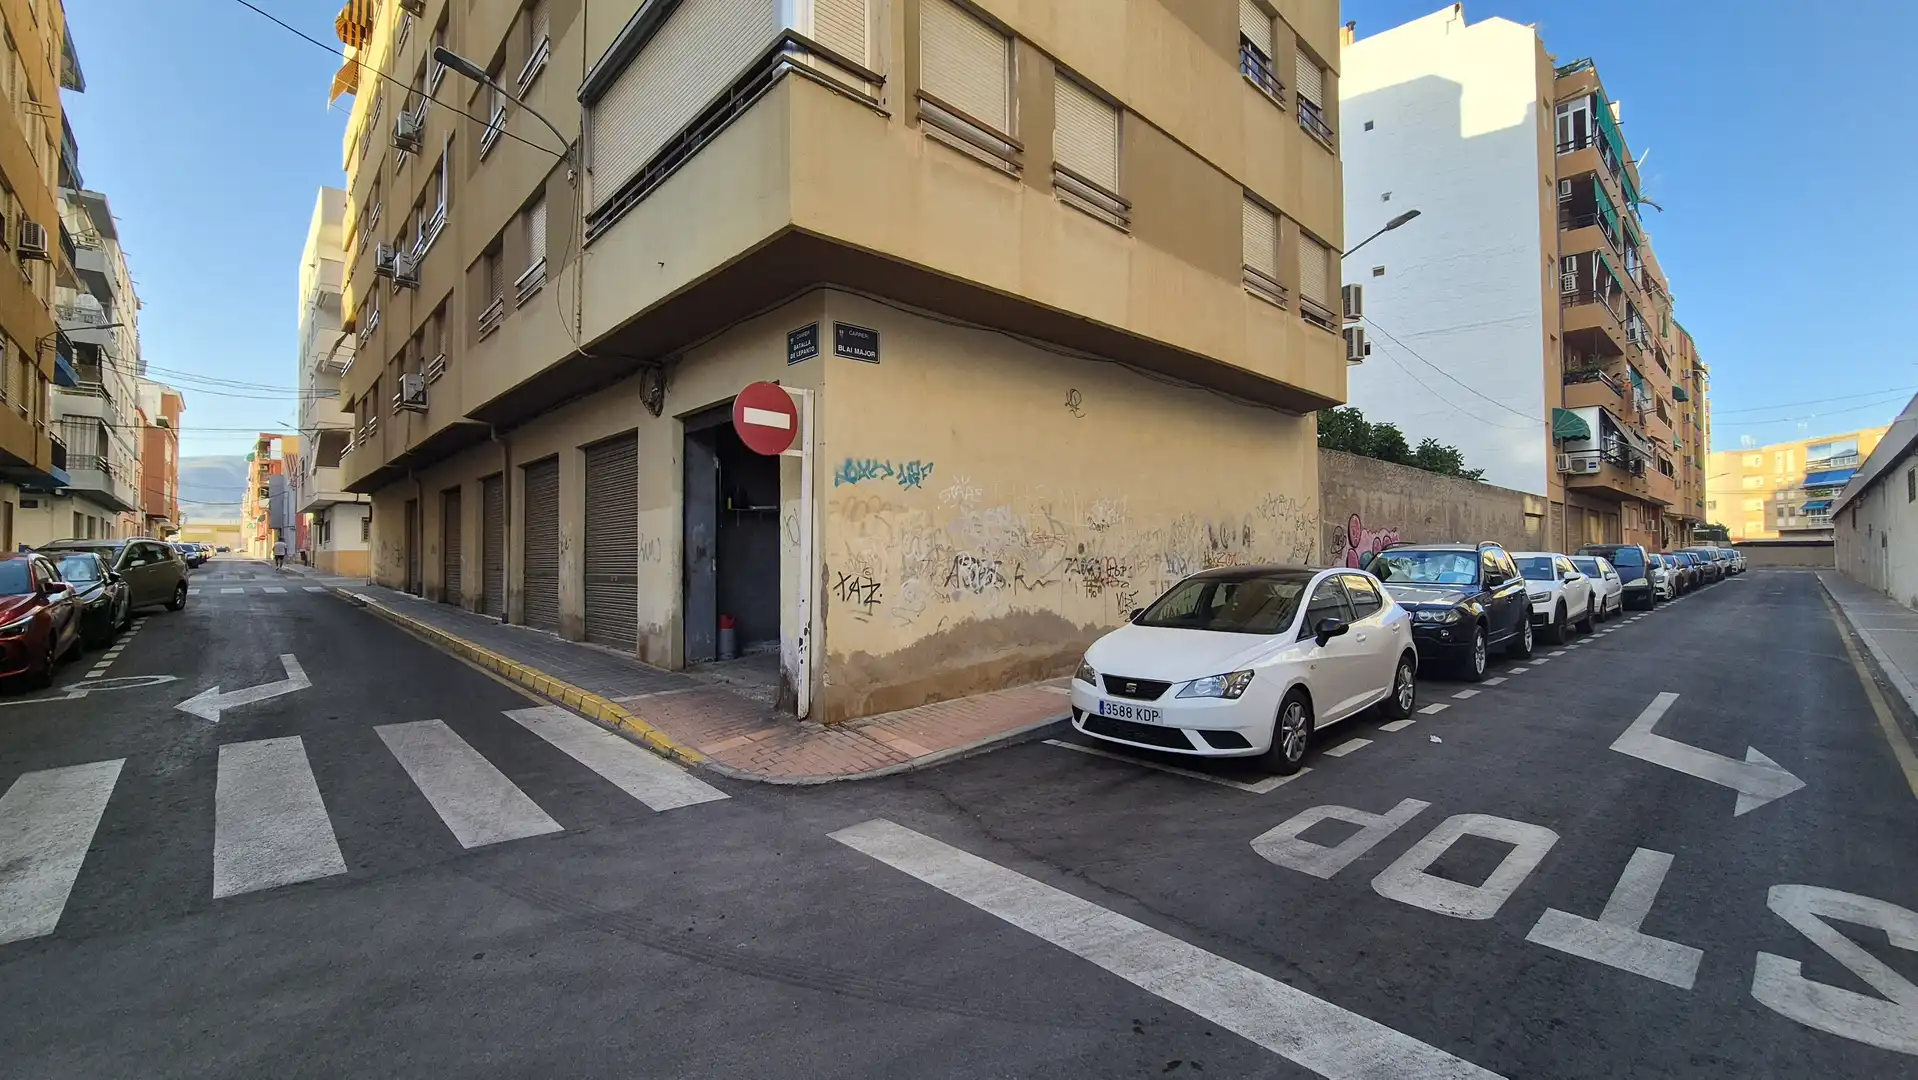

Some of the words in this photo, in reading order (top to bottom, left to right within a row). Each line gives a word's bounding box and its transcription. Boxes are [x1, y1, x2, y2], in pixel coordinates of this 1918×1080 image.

[848, 330, 869, 339] CARRER
[793, 340, 811, 351] BATALLA
[838, 345, 853, 354] BLAI
[855, 347, 876, 358] MAJOR
[790, 352, 796, 360] DE
[797, 346, 815, 358] LEPANTO
[1106, 703, 1132, 718] 3588
[1136, 708, 1159, 722] KDP
[1249, 797, 1918, 1055] STOP
